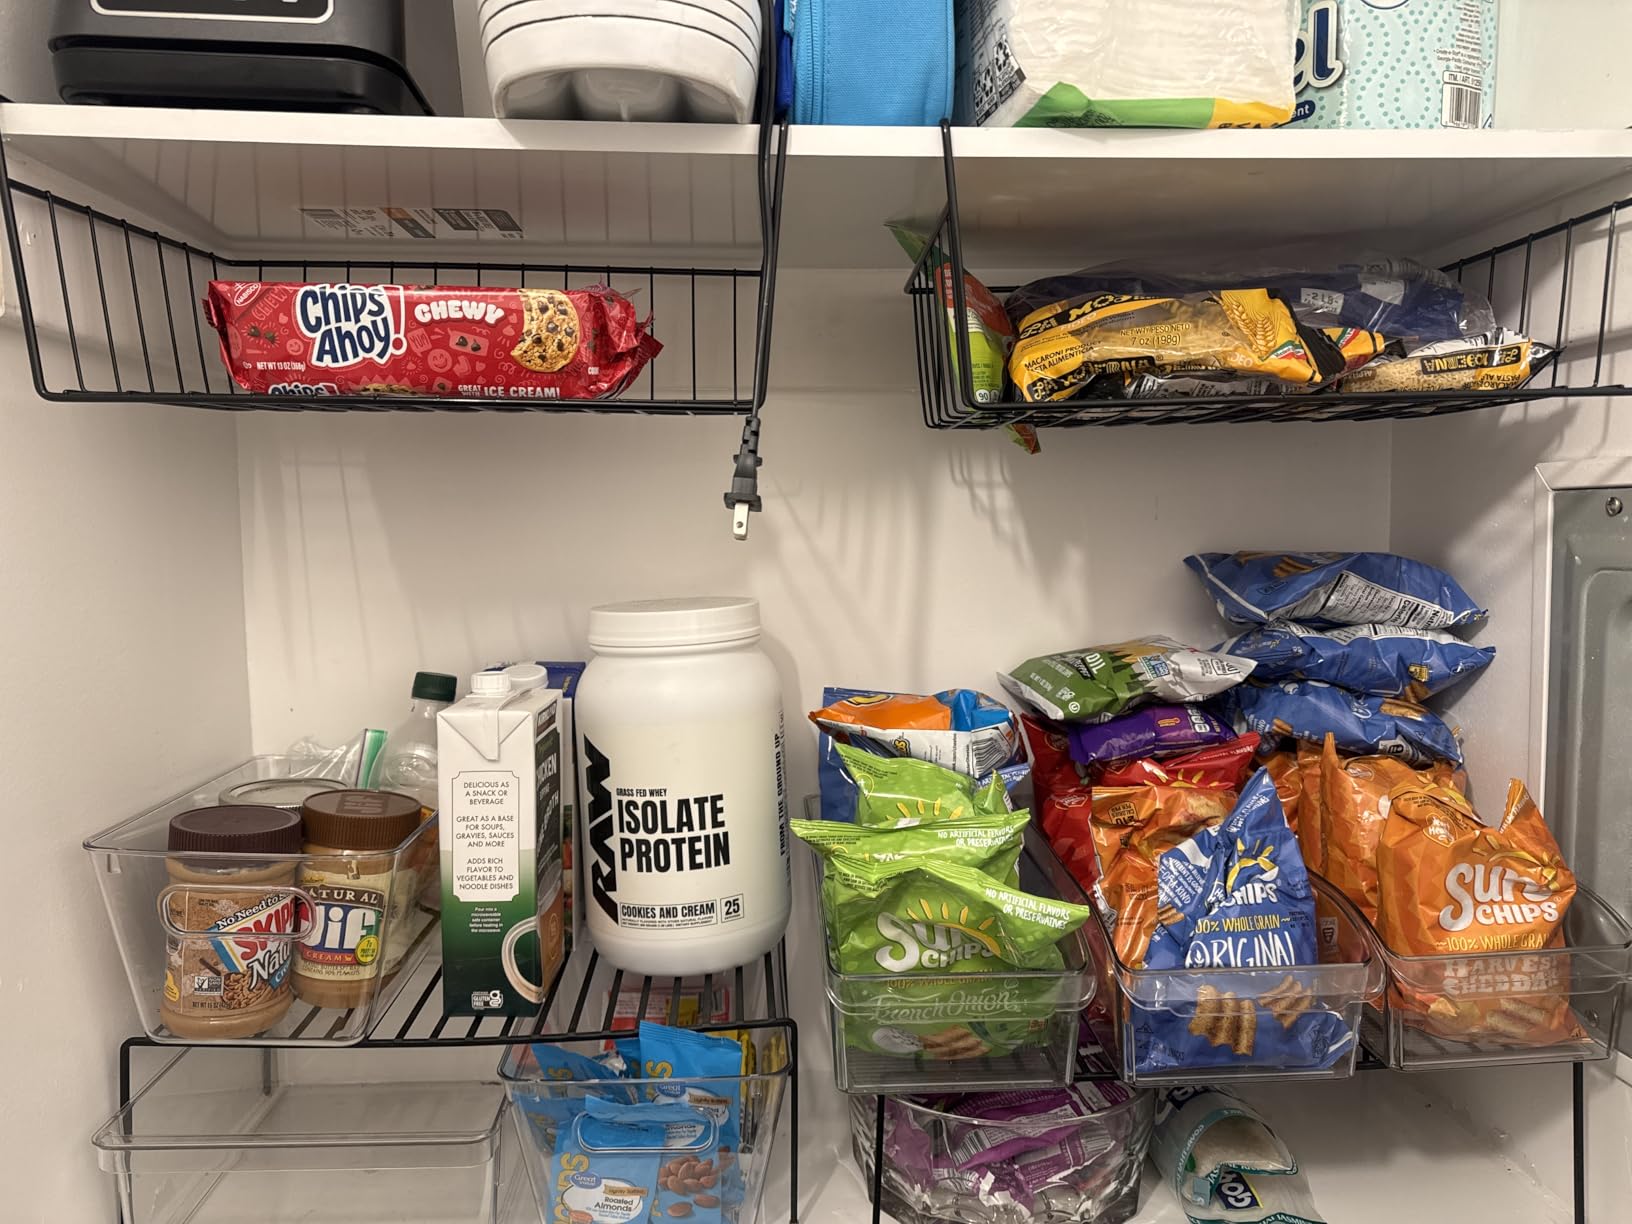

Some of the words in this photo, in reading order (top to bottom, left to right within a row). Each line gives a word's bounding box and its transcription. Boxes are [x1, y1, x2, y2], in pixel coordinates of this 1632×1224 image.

[235, 283, 259, 305] NABISCO
[300, 284, 387, 334] Chips
[413, 299, 505, 326] CHEWY
[1131, 336, 1137, 345] 7
[1138, 337, 1150, 345] oz
[1152, 332, 1181, 346] (198g)
[256, 361, 268, 371] NET
[268, 361, 277, 371] WT
[277, 361, 283, 371] 13
[284, 361, 291, 371] OZ
[1024, 349, 1064, 370] MACARONI
[484, 386, 505, 397] ICE
[509, 386, 561, 398] CREAM!
[978, 391, 989, 401] 90
[774, 733, 781, 749] UP
[775, 751, 784, 797] GROUND
[463, 781, 499, 789] DELICIOUS
[616, 787, 635, 797] GRASS
[636, 789, 647, 797] FED
[649, 788, 667, 797] WHEY
[616, 793, 726, 835] ISOLATE
[777, 800, 785, 822] THE
[937, 830, 948, 839] NO
[949, 829, 986, 839] ARTIFICIAL
[955, 837, 966, 847] OR
[619, 831, 731, 873] PROTEIN
[308, 887, 378, 904] ATURAL
[985, 887, 997, 899] NO
[998, 891, 1038, 910] ARTIFICIAL
[1039, 902, 1071, 920] FLAVORS
[1221, 882, 1278, 906] HIPS
[1438, 862, 1552, 932] Sun
[217, 915, 236, 930] No
[235, 900, 268, 920] Need
[267, 895, 279, 907] to
[621, 905, 656, 919] COOKIES
[659, 906, 678, 919] AND
[681, 902, 715, 918] CREAM
[724, 898, 740, 916] 25
[1003, 905, 1014, 916] OR
[1475, 903, 1559, 926] CHIPS
[233, 899, 295, 961] SKIP
[300, 905, 376, 950] Jif
[1195, 920, 1219, 934] 00%
[1222, 917, 1254, 932] WHOLE
[1254, 914, 1280, 931] GRAIN
[1446, 937, 1480, 952] 100%
[1481, 935, 1518, 950] WHOLE
[247, 938, 291, 992] Natu
[275, 962, 291, 982] Cre
[192, 1001, 200, 1009] NET
[200, 1001, 207, 1009] WT
[868, 994, 946, 1021] French
[950, 986, 1011, 1016] Onion
[574, 1173, 597, 1183] Great
[1220, 1171, 1253, 1208] GOY
[594, 1201, 633, 1212] Almonds
[604, 1196, 634, 1206] Roasted
